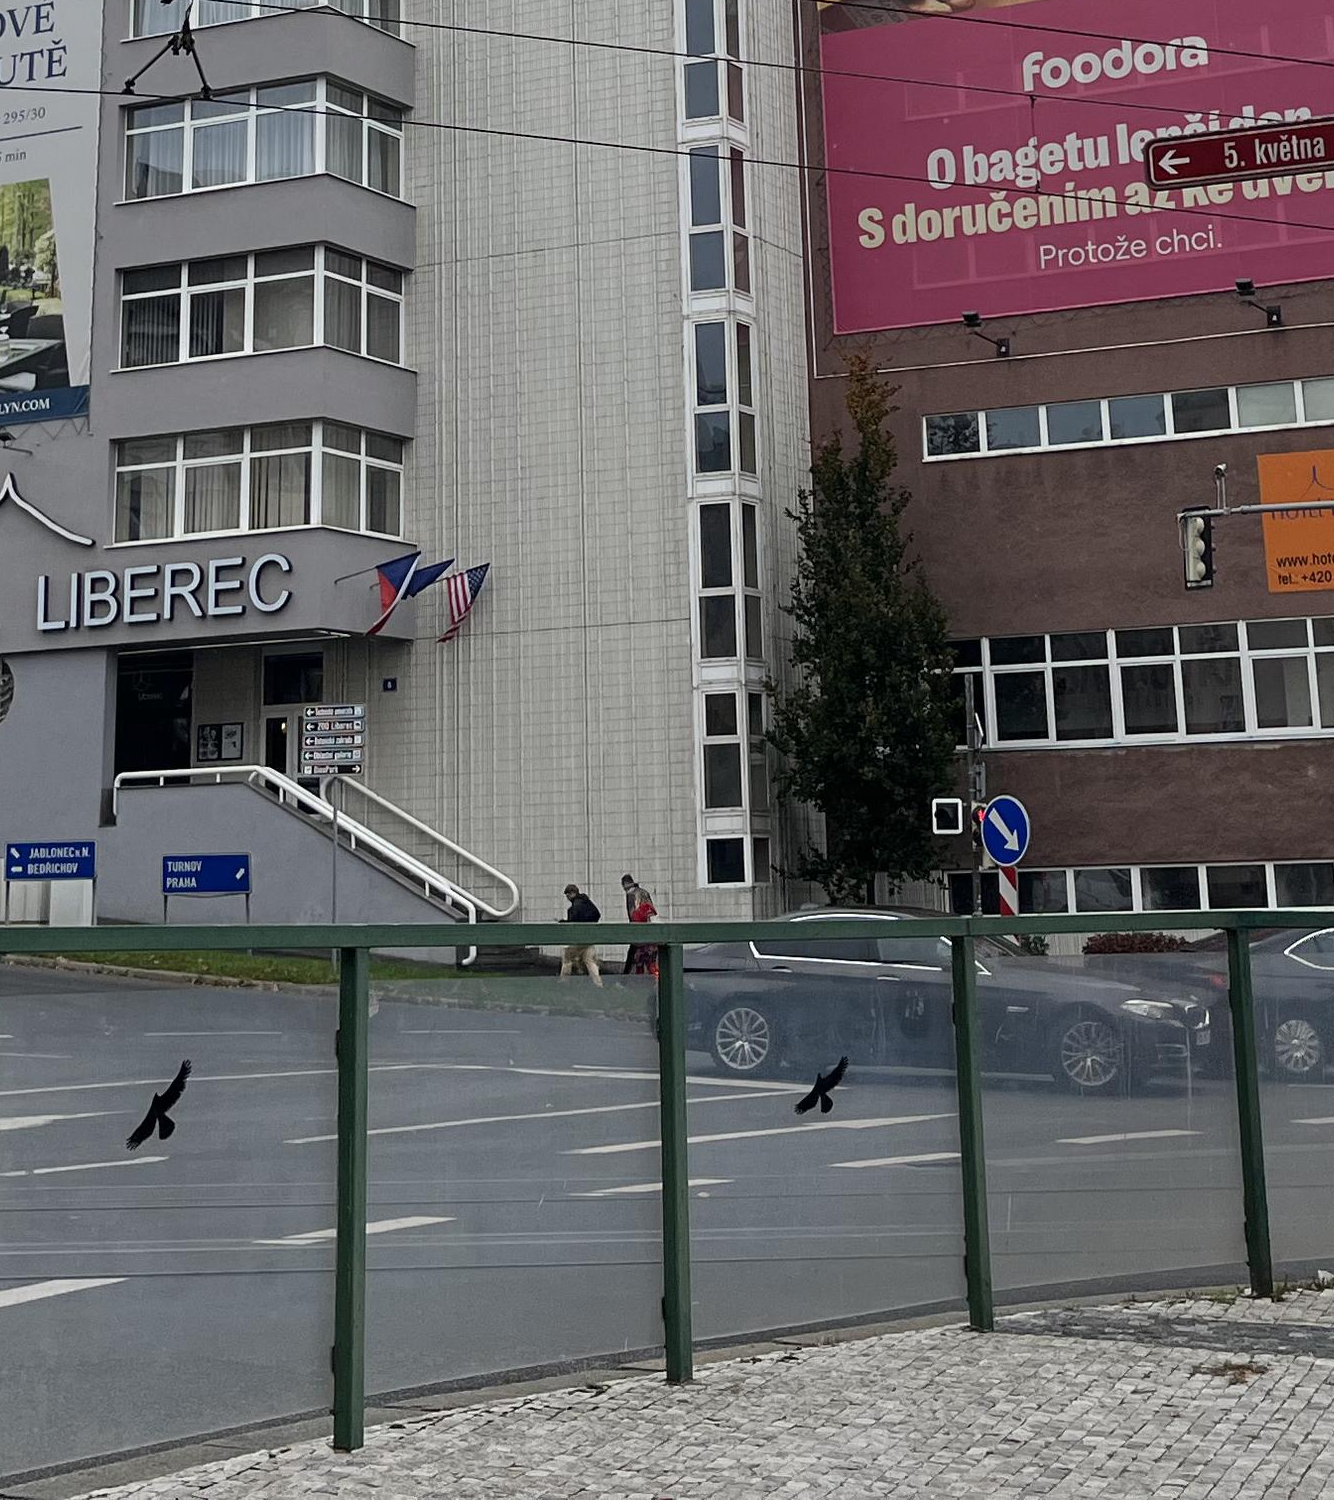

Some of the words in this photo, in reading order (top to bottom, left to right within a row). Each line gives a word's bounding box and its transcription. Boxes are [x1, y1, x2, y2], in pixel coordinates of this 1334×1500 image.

[1022, 33, 1210, 92] foodora
[3, 106, 46, 125] 295/30
[5, 150, 27, 163] min
[927, 148, 956, 191] O
[963, 130, 1110, 188] bagetu
[1223, 142, 1247, 169] 5.
[1254, 135, 1326, 166] května
[857, 208, 886, 249] S
[892, 184, 1116, 244] doručením
[1039, 225, 1147, 270] Protože
[1153, 223, 1224, 261] chci.
[1301, 570, 1332, 583] +420
[36, 552, 292, 631] LIBEREC
[29, 847, 75, 859] JABLONEC
[27, 861, 78, 874] BEDŘICHOV
[167, 861, 202, 872] TURNOV
[167, 877, 197, 888] PRAHA
